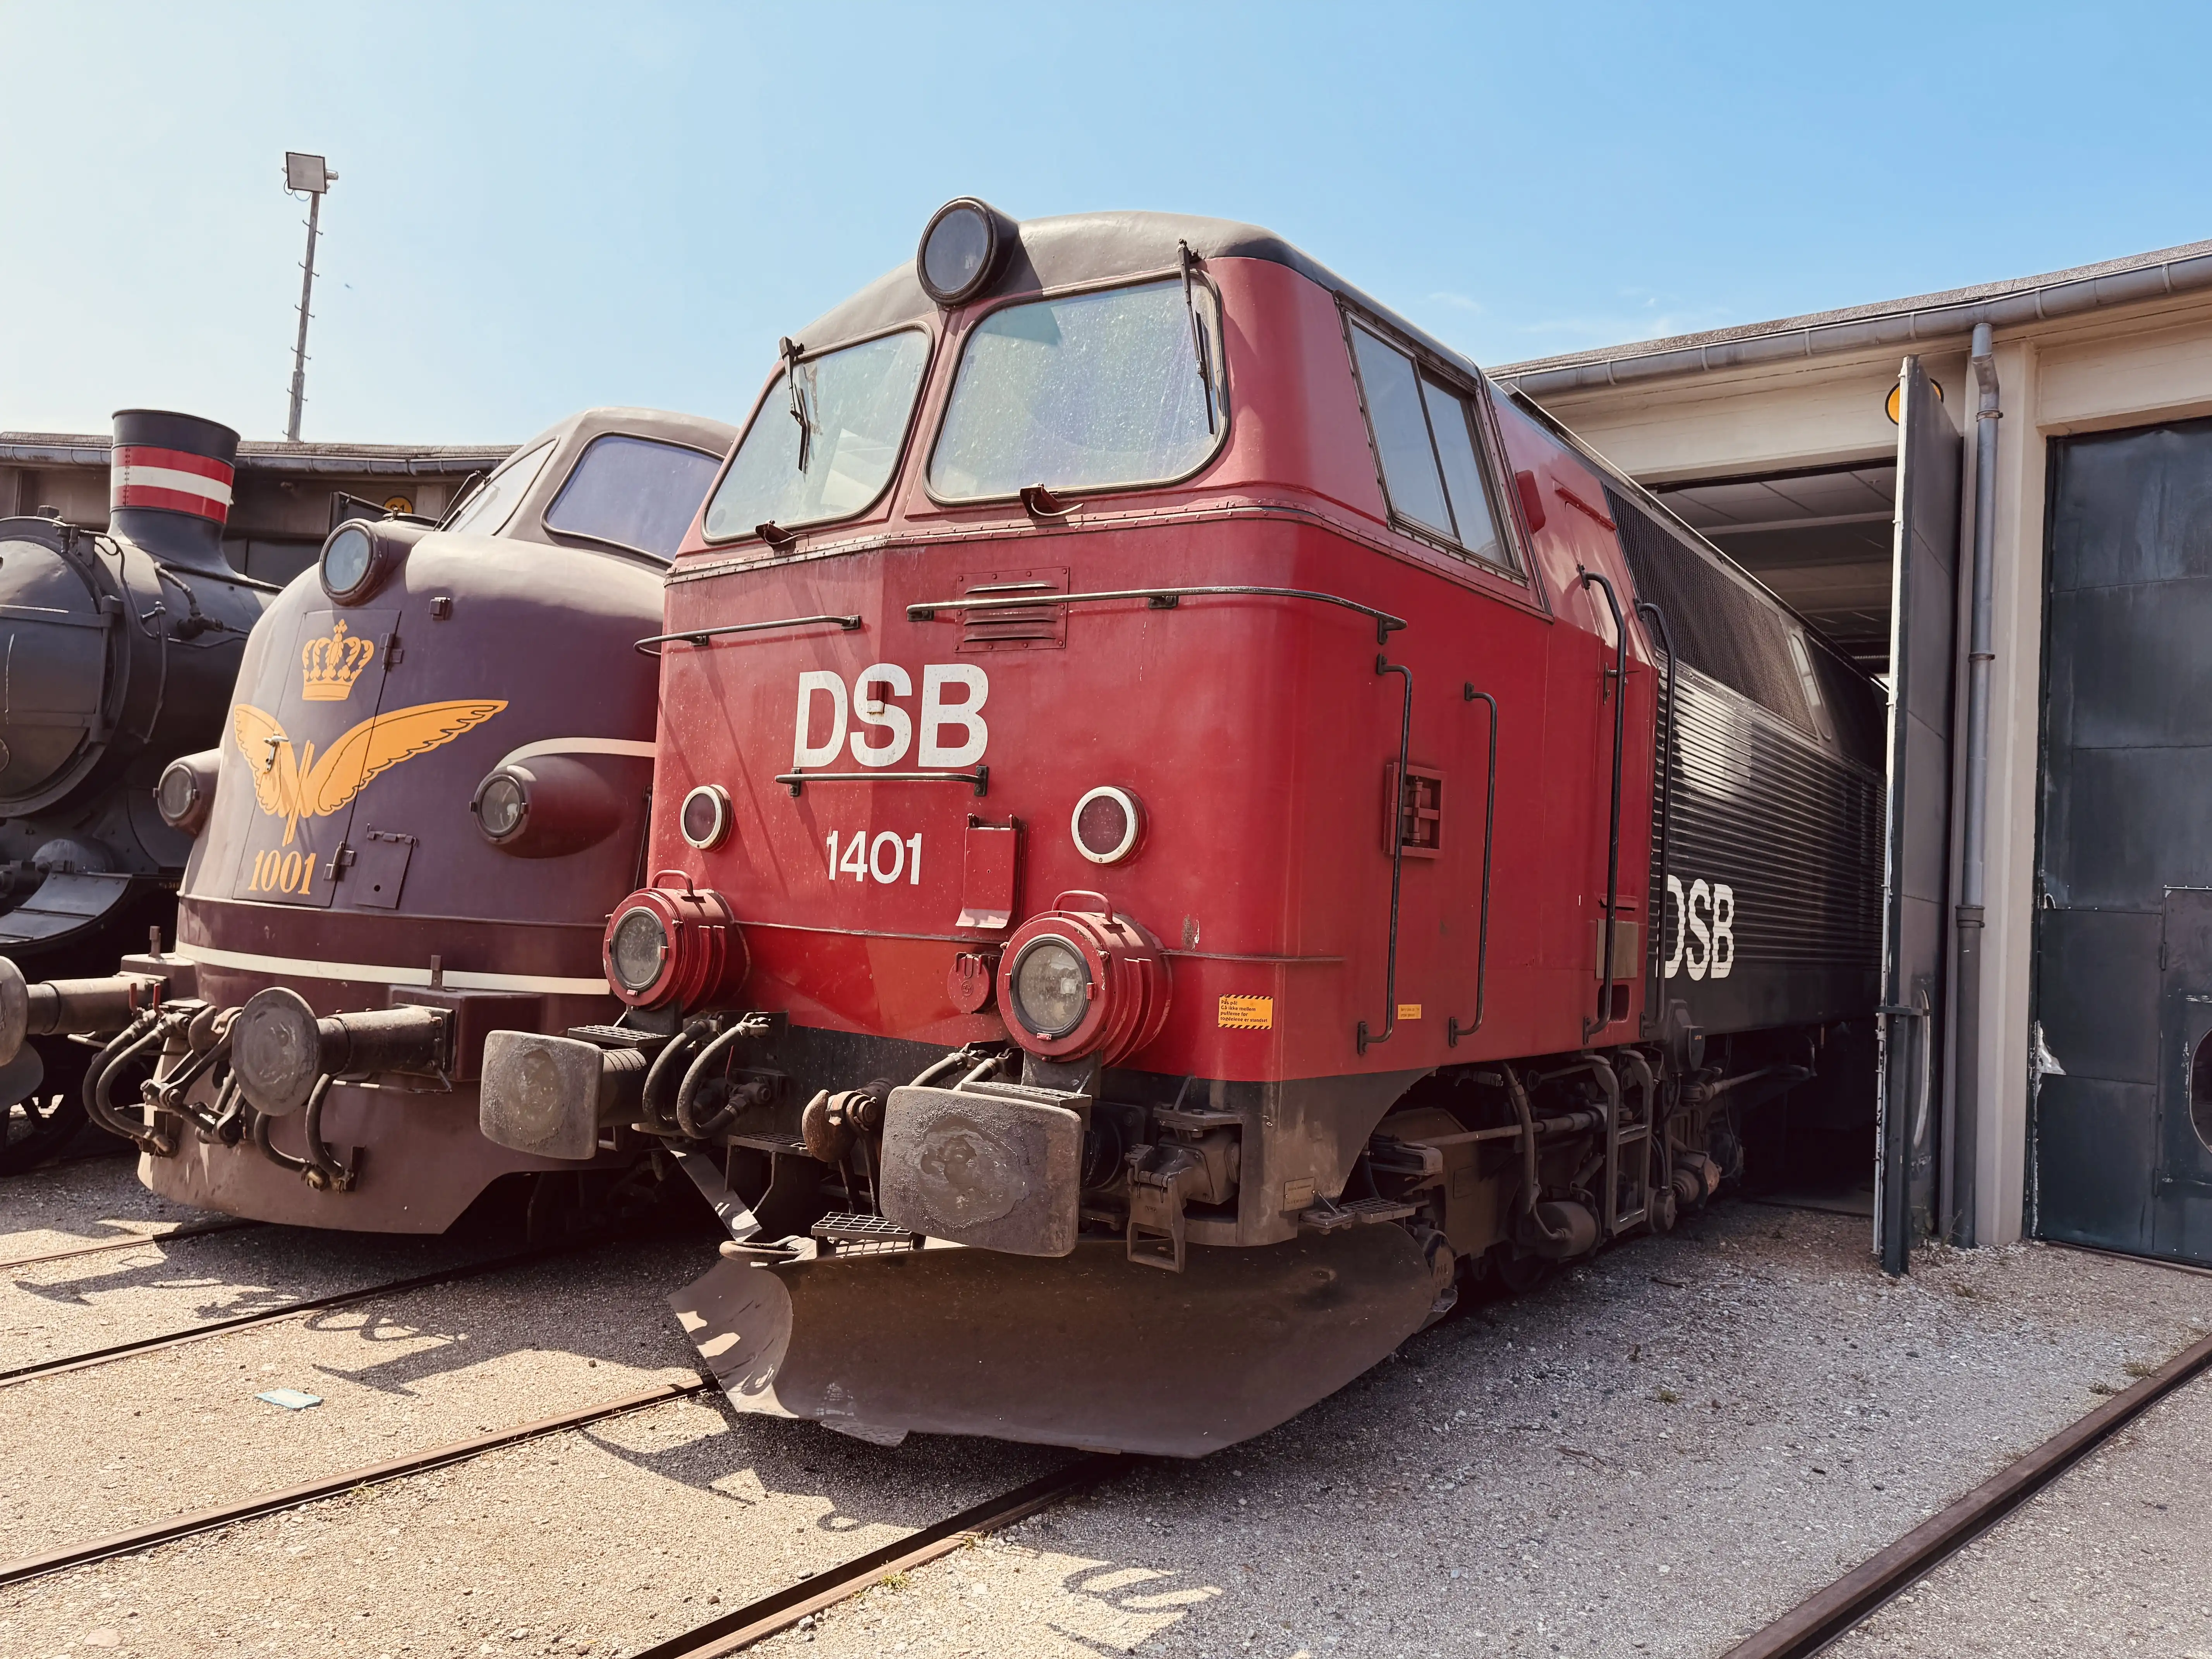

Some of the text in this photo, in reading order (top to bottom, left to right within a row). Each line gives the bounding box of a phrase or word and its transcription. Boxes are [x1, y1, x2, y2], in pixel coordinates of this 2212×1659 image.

[793, 663, 989, 767] DSB
[248, 850, 316, 895] 1001
[826, 830, 922, 885] 1401
[1656, 874, 1734, 981] DSB
